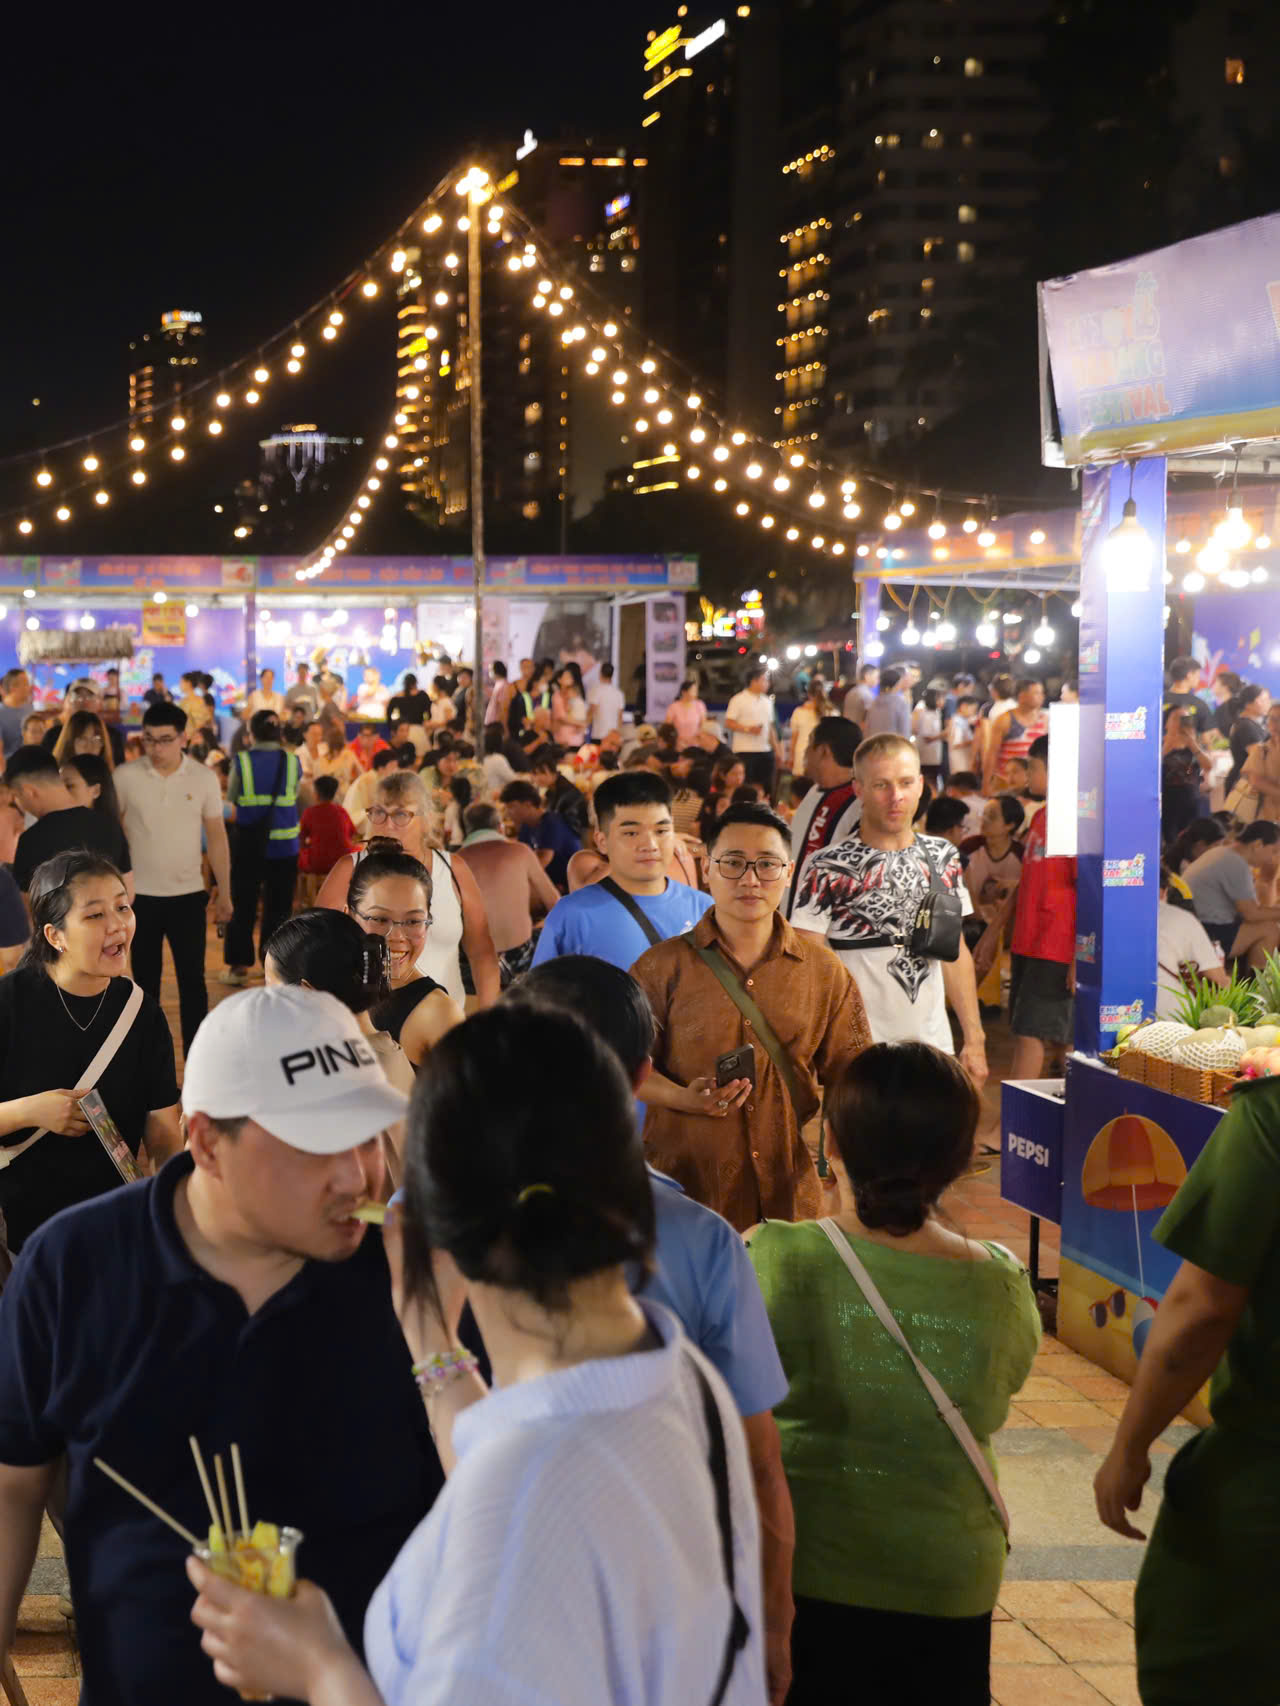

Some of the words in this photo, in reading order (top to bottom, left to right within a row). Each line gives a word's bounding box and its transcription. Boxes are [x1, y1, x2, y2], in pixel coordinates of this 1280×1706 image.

[809, 806, 829, 841] FILA
[280, 1038, 376, 1086] PING
[1008, 1131, 1049, 1168] PEPSI
